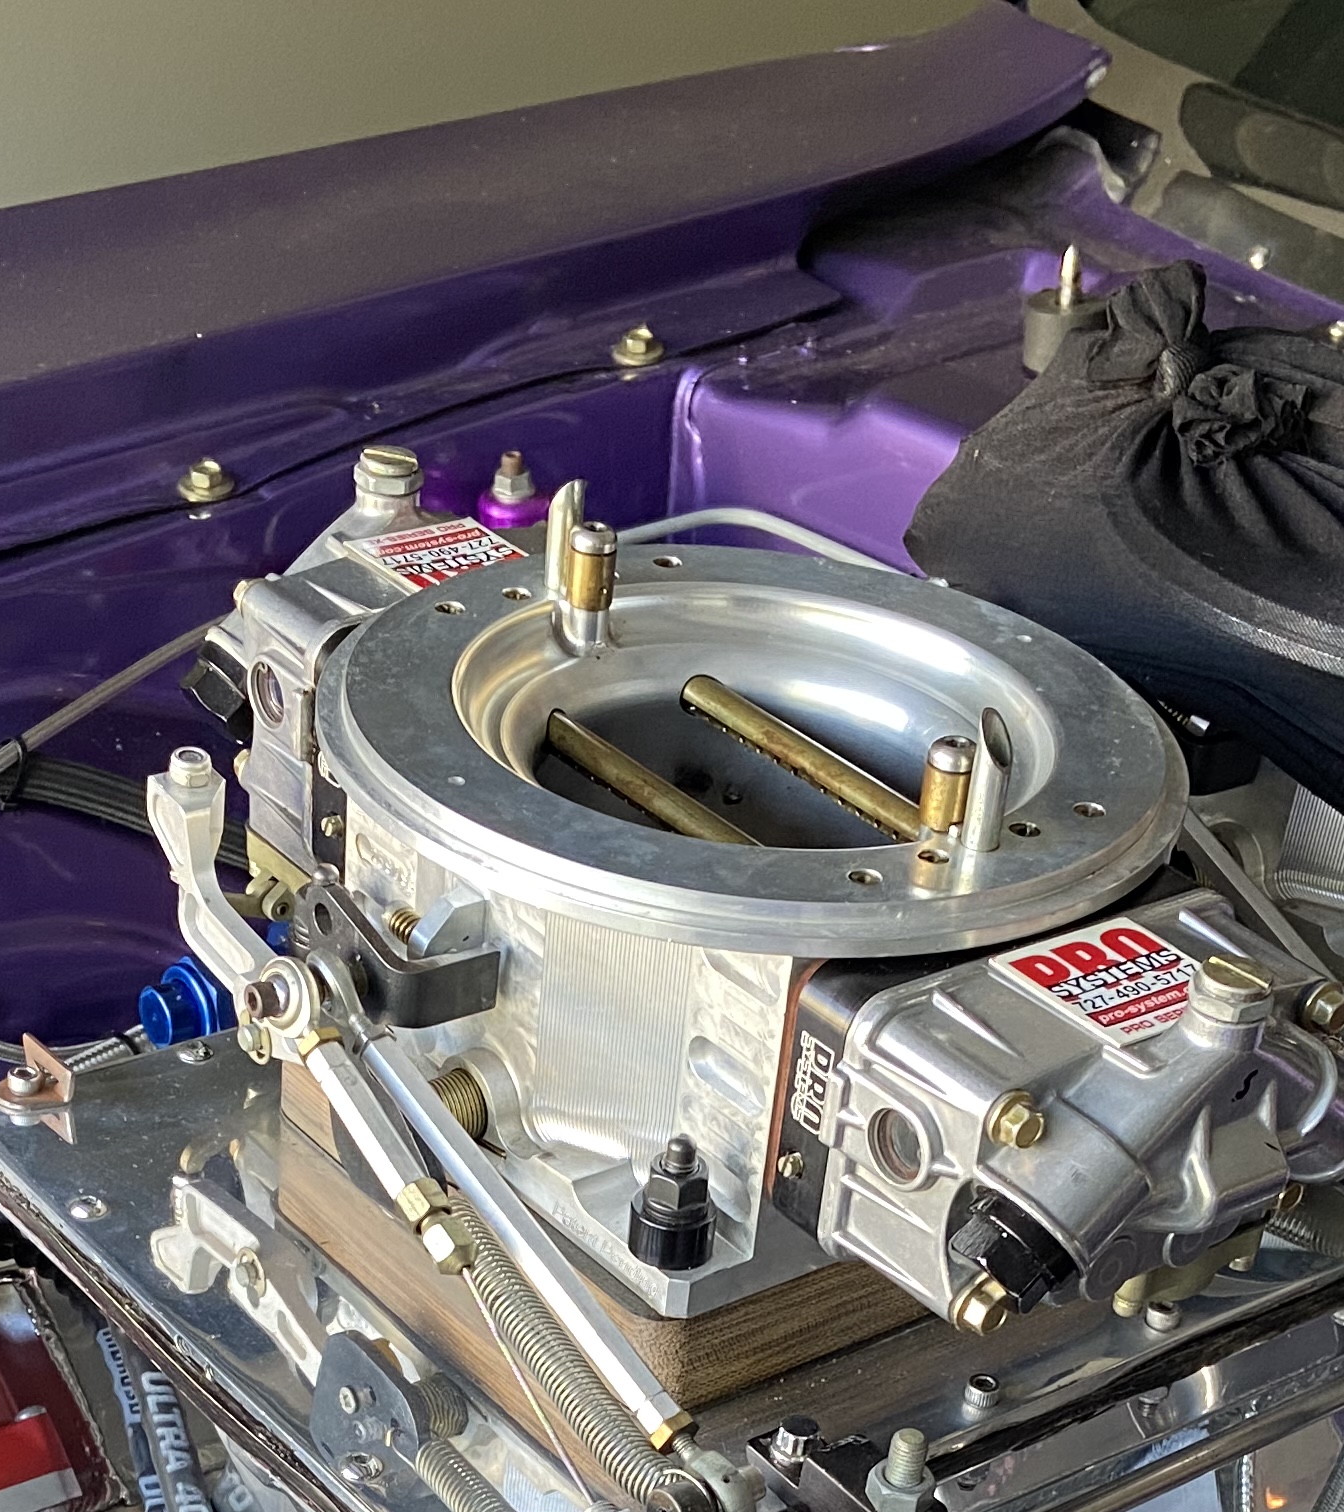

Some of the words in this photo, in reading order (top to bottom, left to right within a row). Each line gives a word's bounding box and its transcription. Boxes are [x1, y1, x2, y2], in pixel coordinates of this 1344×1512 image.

[383, 537, 501, 567] 727-490-5717
[1050, 950, 1180, 998] SYSTEMS
[1071, 964, 1197, 1012] 727-490-5717
[141, 1370, 194, 1474] ULTRA
